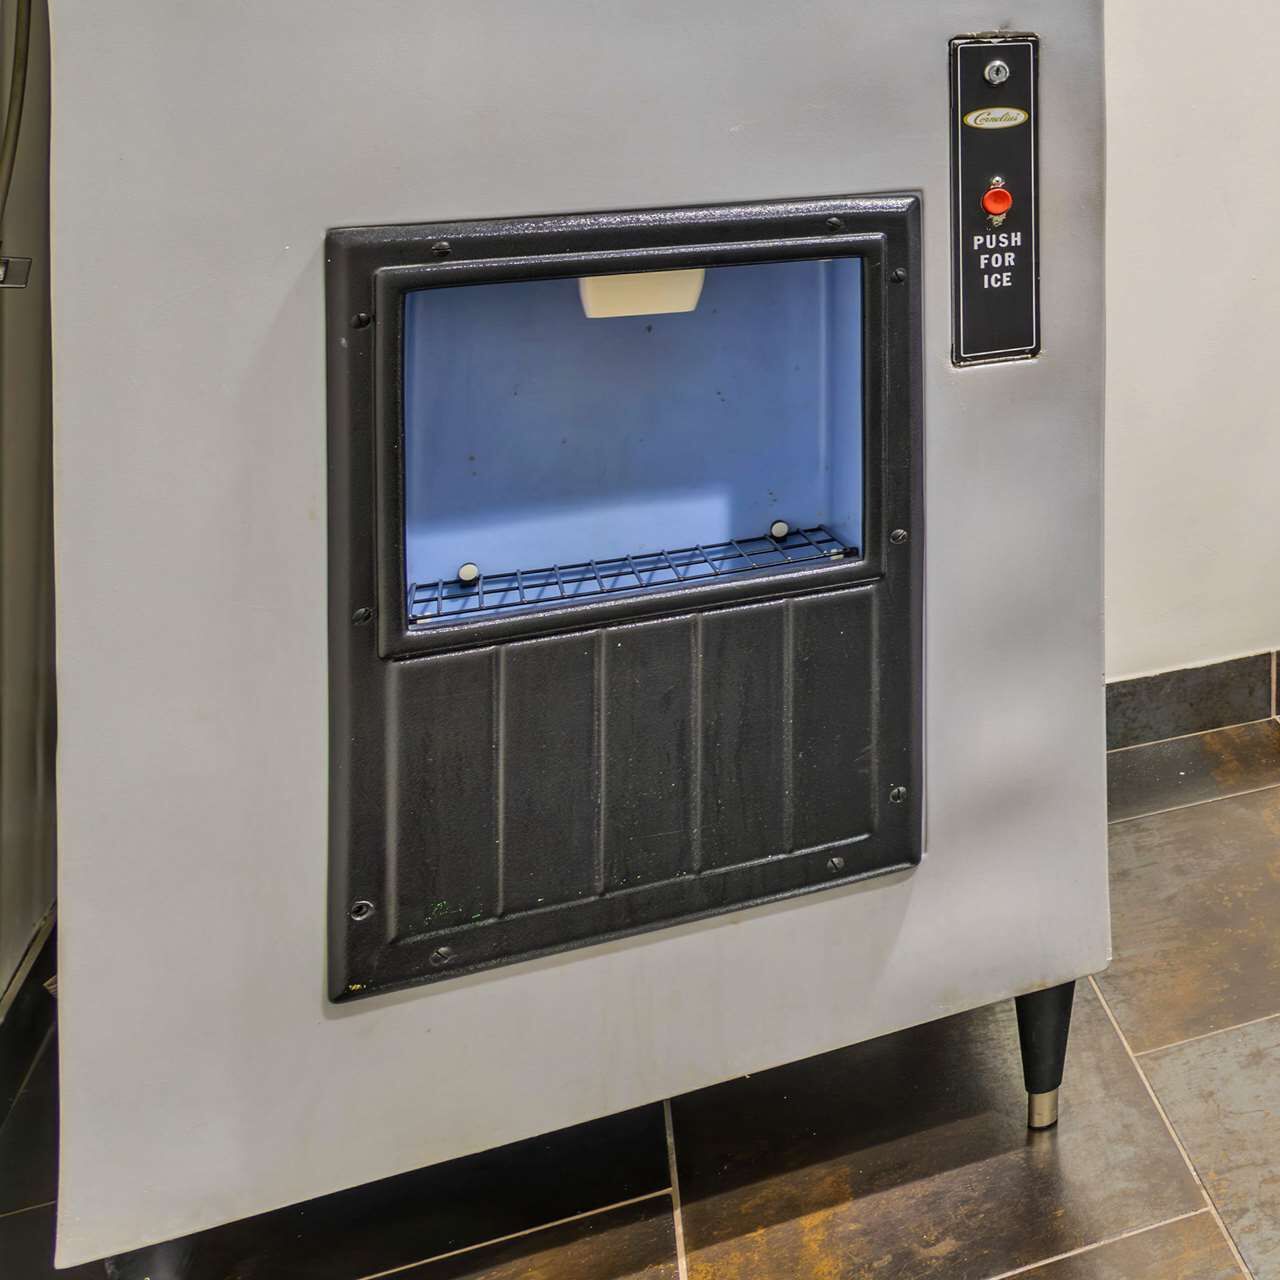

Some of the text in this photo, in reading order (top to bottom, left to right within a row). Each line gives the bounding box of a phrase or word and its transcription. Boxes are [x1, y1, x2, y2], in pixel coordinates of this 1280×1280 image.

[973, 231, 1022, 251] PUSH
[979, 252, 1016, 269] FOR
[983, 272, 1012, 289] ICE
